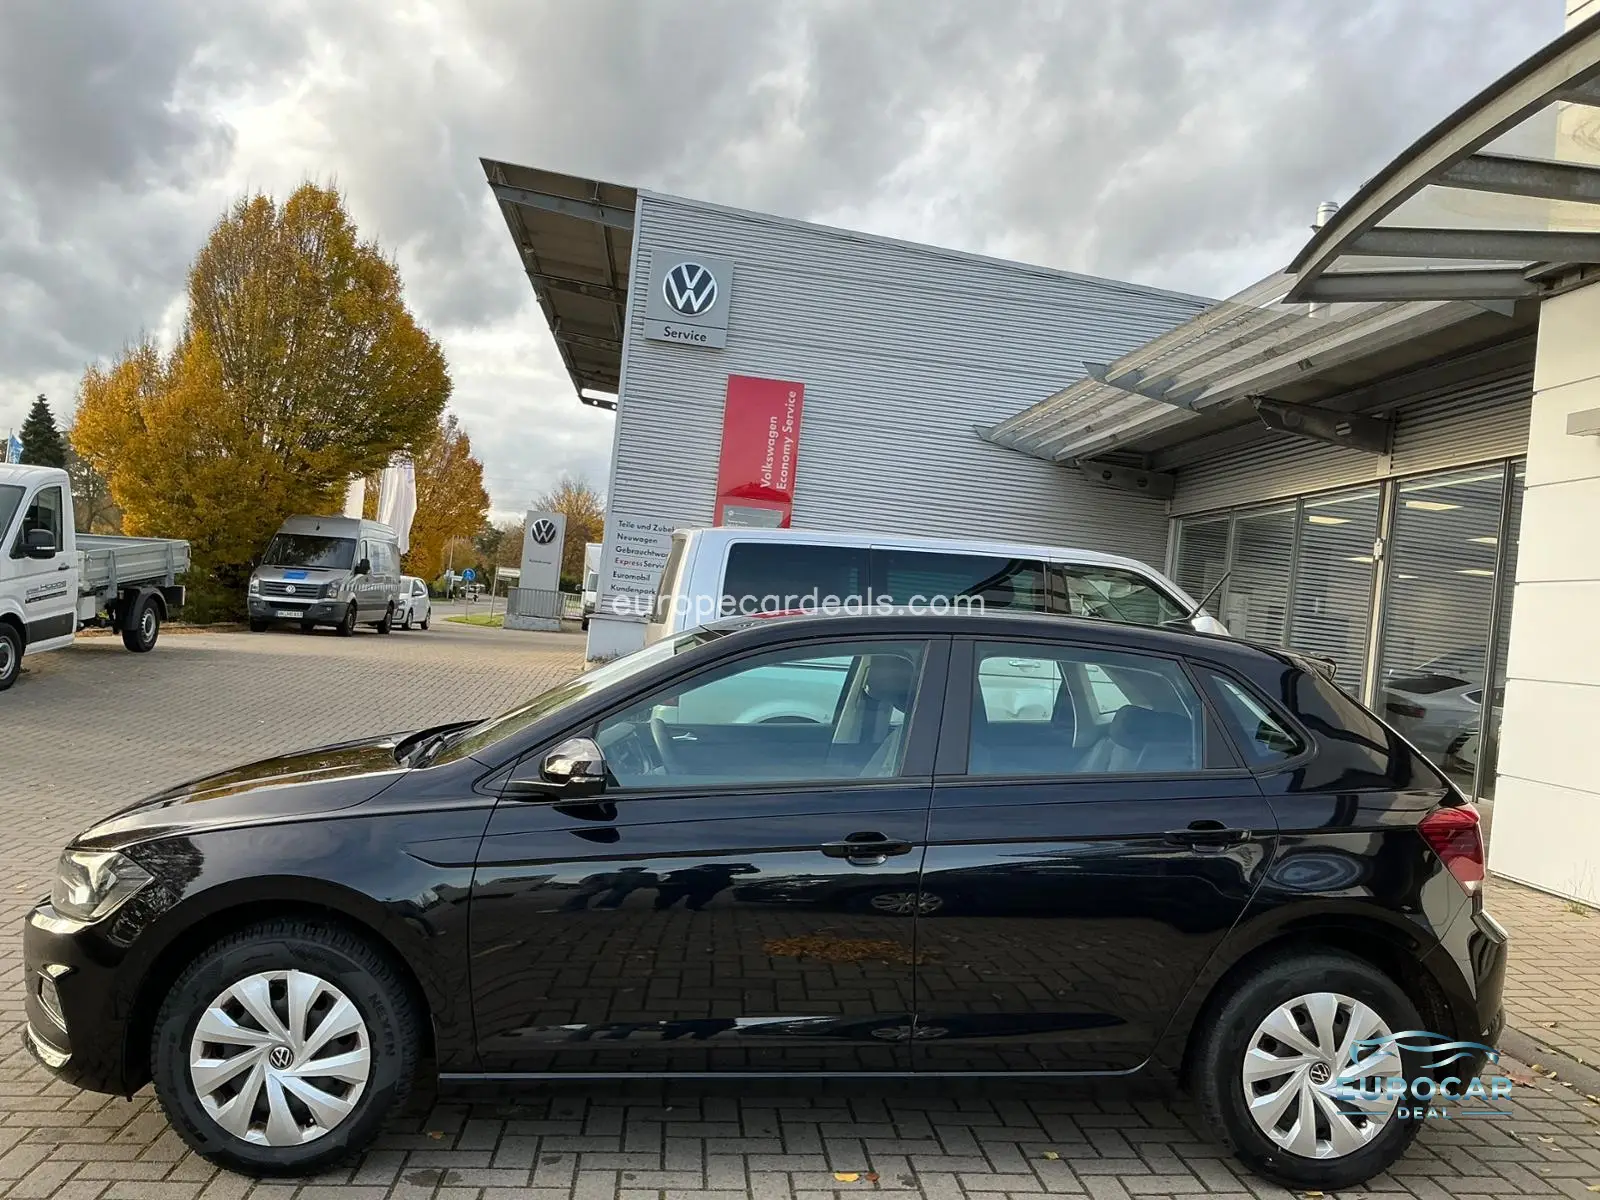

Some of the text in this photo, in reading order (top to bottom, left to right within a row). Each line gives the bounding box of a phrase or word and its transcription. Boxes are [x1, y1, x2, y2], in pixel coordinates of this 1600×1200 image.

[663, 262, 718, 317] VW
[663, 326, 707, 342] Service
[776, 391, 797, 490] Economy Service
[760, 416, 779, 488] Volkswagen
[618, 520, 635, 529] Teile
[617, 533, 657, 544] Neuwagen
[613, 571, 650, 581] Euromobil
